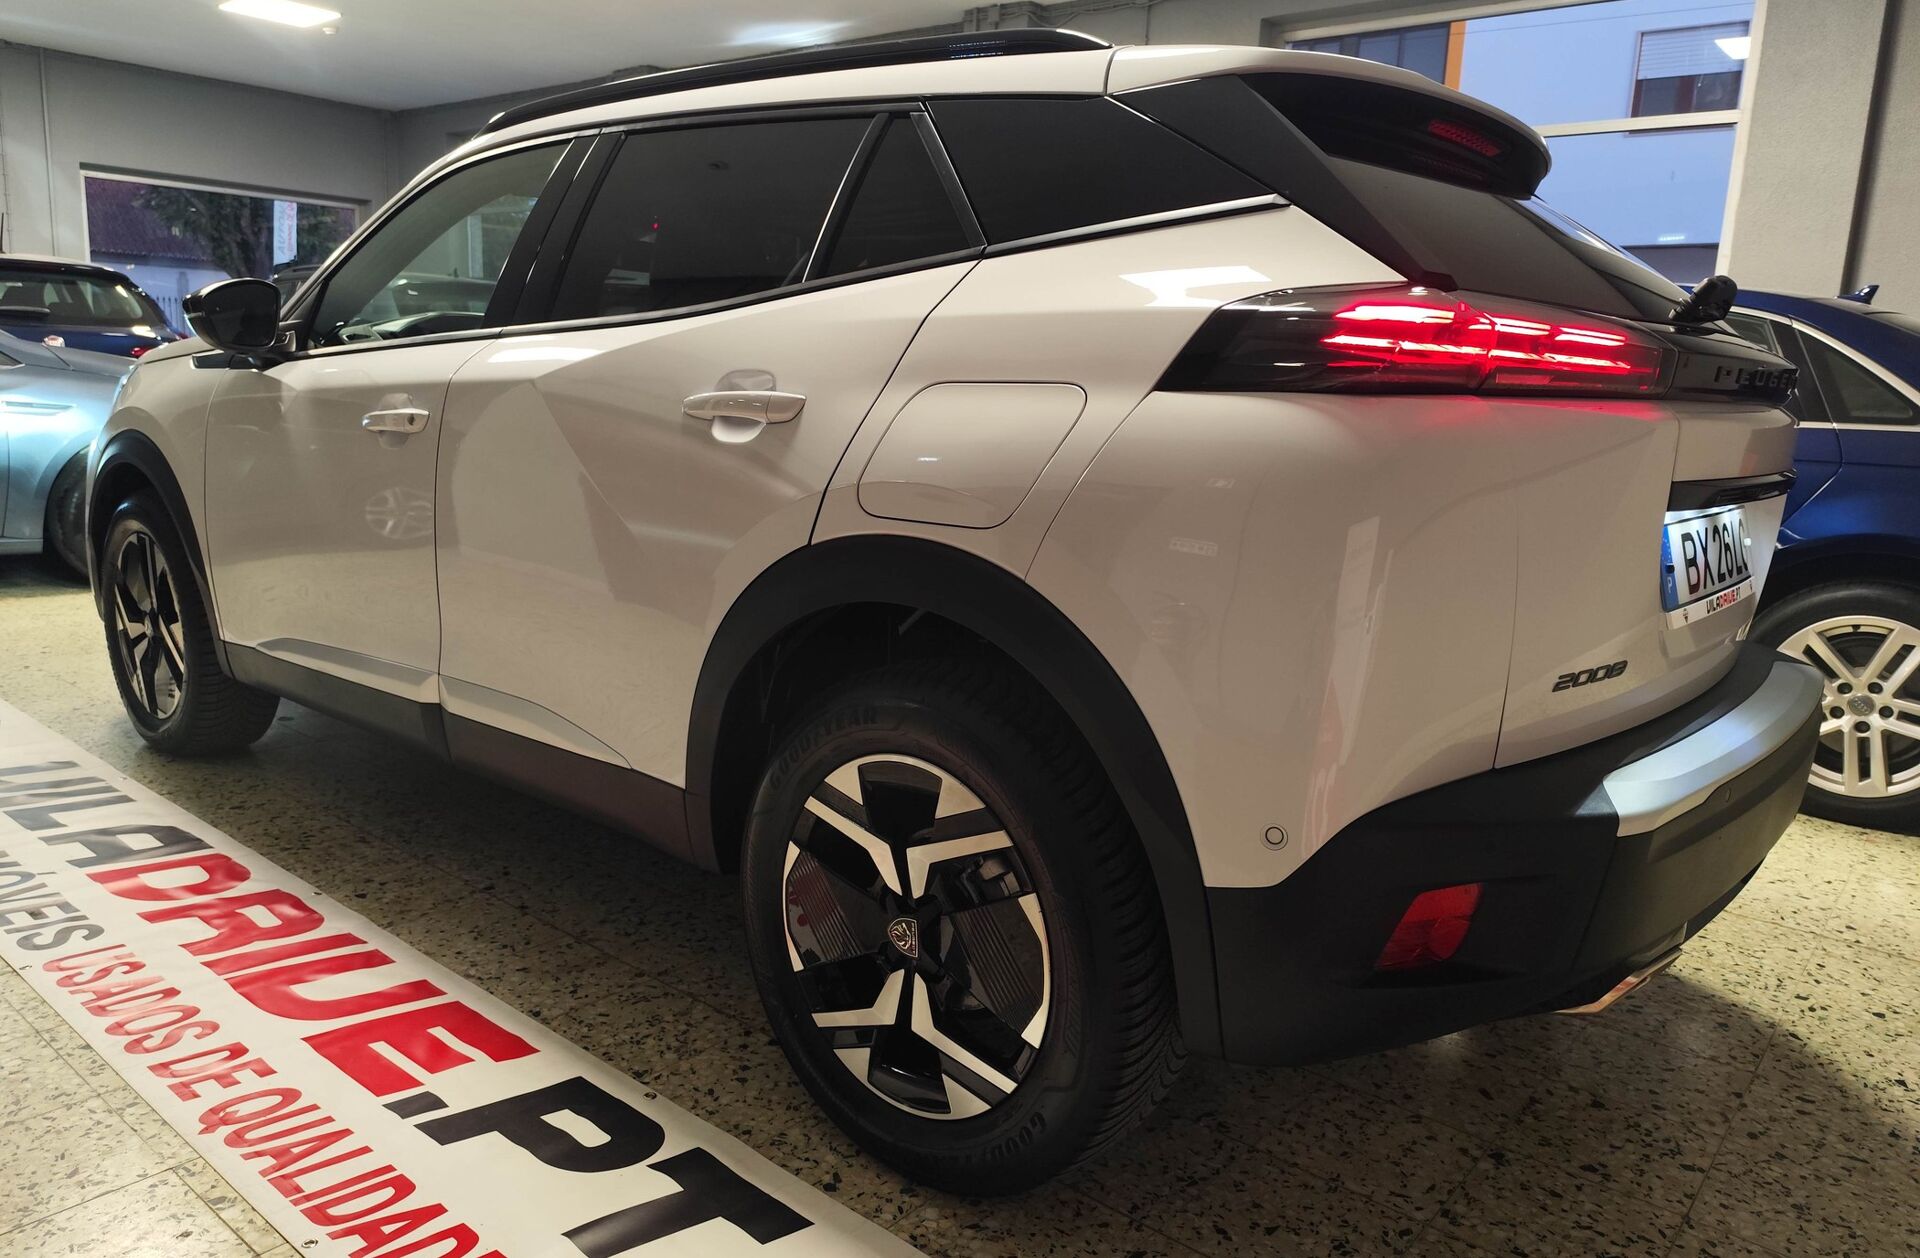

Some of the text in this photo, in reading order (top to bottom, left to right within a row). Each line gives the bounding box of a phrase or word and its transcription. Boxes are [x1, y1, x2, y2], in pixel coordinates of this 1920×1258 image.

[1552, 660, 1628, 692] 2008
[0, 850, 510, 1258] ÓVEIS USADOS DE QUALIDAD
